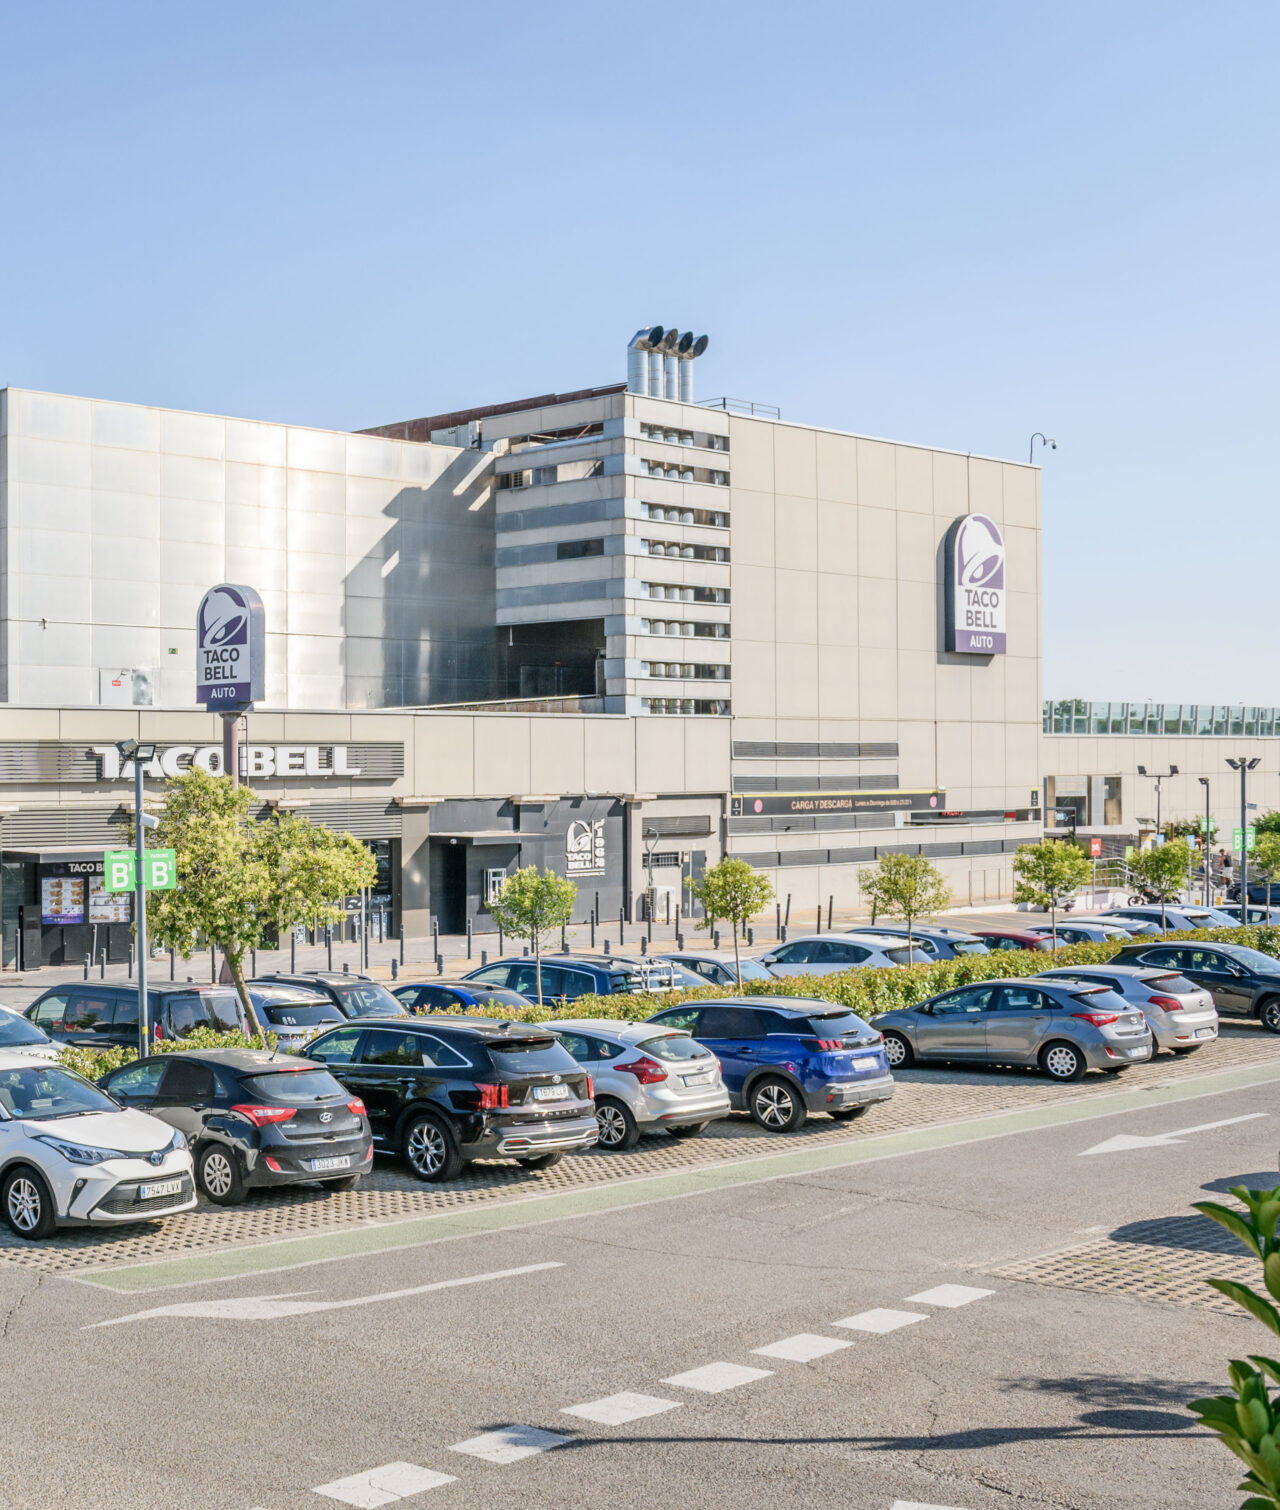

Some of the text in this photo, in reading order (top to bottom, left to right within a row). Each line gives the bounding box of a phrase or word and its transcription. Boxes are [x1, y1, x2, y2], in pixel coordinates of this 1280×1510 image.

[965, 589, 999, 608] TACO
[966, 610, 997, 628] BELL
[970, 635, 993, 648] AUTO
[203, 648, 240, 664] TACO
[204, 665, 237, 681] BELL
[211, 687, 236, 699] AUTO
[92, 746, 361, 779] TACO BELL
[791, 800, 814, 810] CARGA
[820, 799, 852, 809] DESCARGA
[566, 853, 592, 861] TACO
[68, 863, 95, 873] TACO
[567, 861, 592, 870] BELL
[146, 1181, 180, 1196] 7547 LVX
